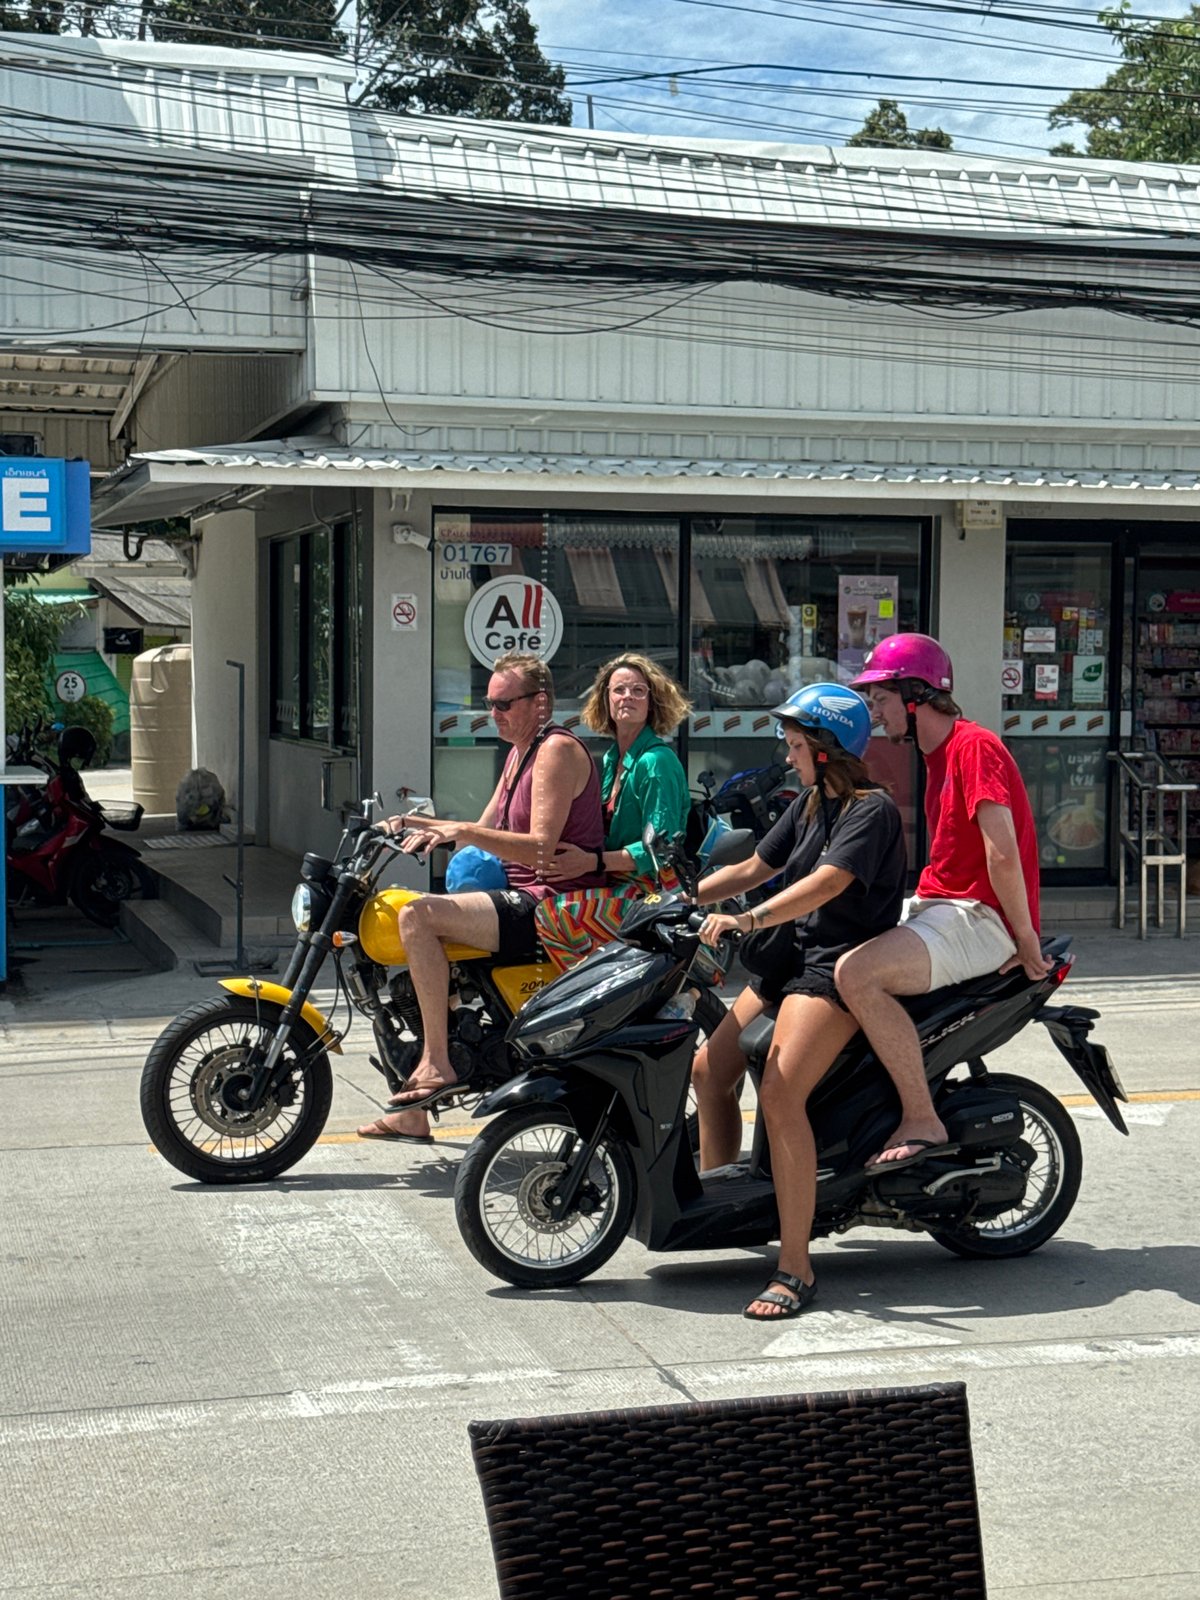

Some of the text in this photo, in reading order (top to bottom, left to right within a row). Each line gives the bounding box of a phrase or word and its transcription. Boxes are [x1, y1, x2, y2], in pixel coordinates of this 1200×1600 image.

[443, 544, 510, 563] 01767
[485, 584, 543, 629] All
[485, 631, 541, 650] Café
[63, 677, 78, 689] 25
[812, 706, 853, 728] HONDA
